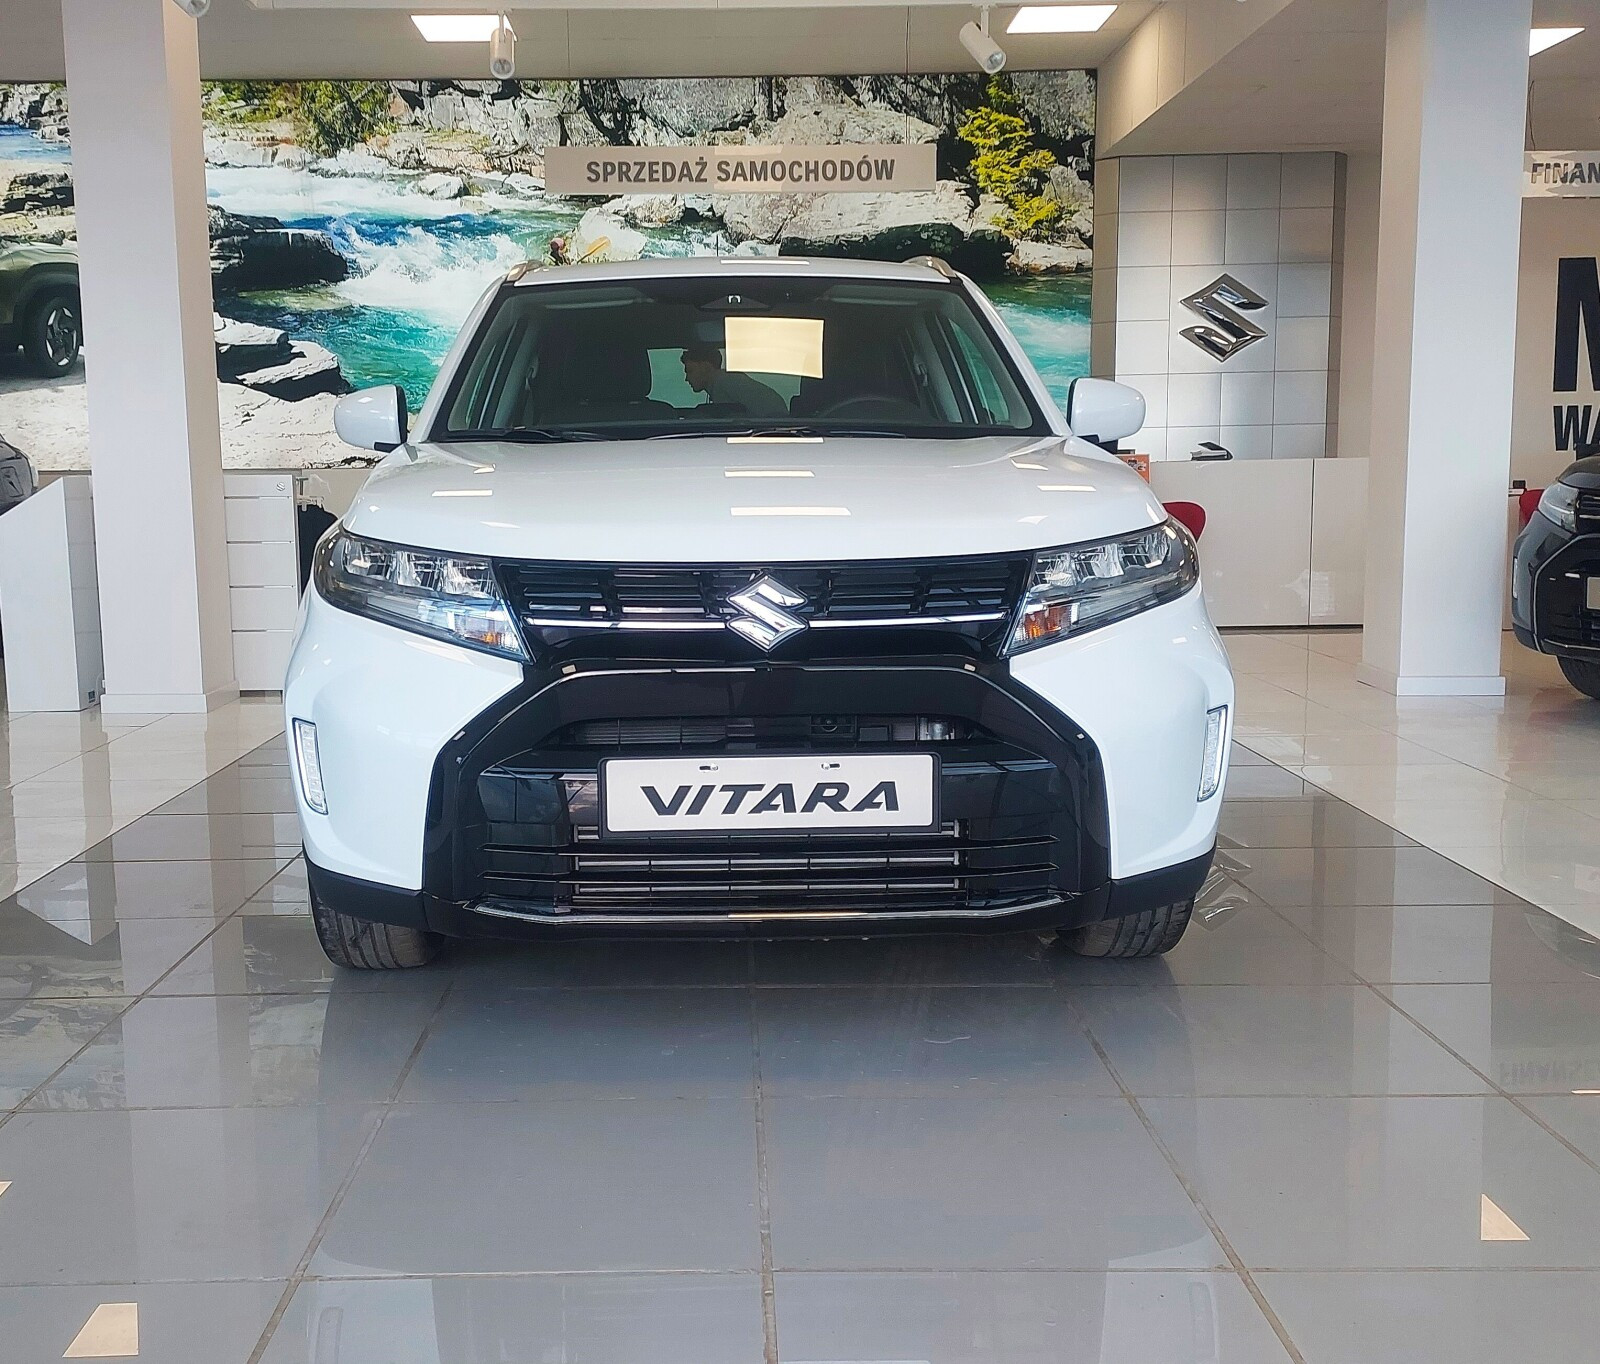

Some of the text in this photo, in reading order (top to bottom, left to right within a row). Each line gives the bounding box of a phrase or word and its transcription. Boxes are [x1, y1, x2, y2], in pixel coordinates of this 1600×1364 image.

[586, 155, 895, 183] SPRZEDAŻ SAMOCHODÓW
[640, 781, 899, 816] VITARA
